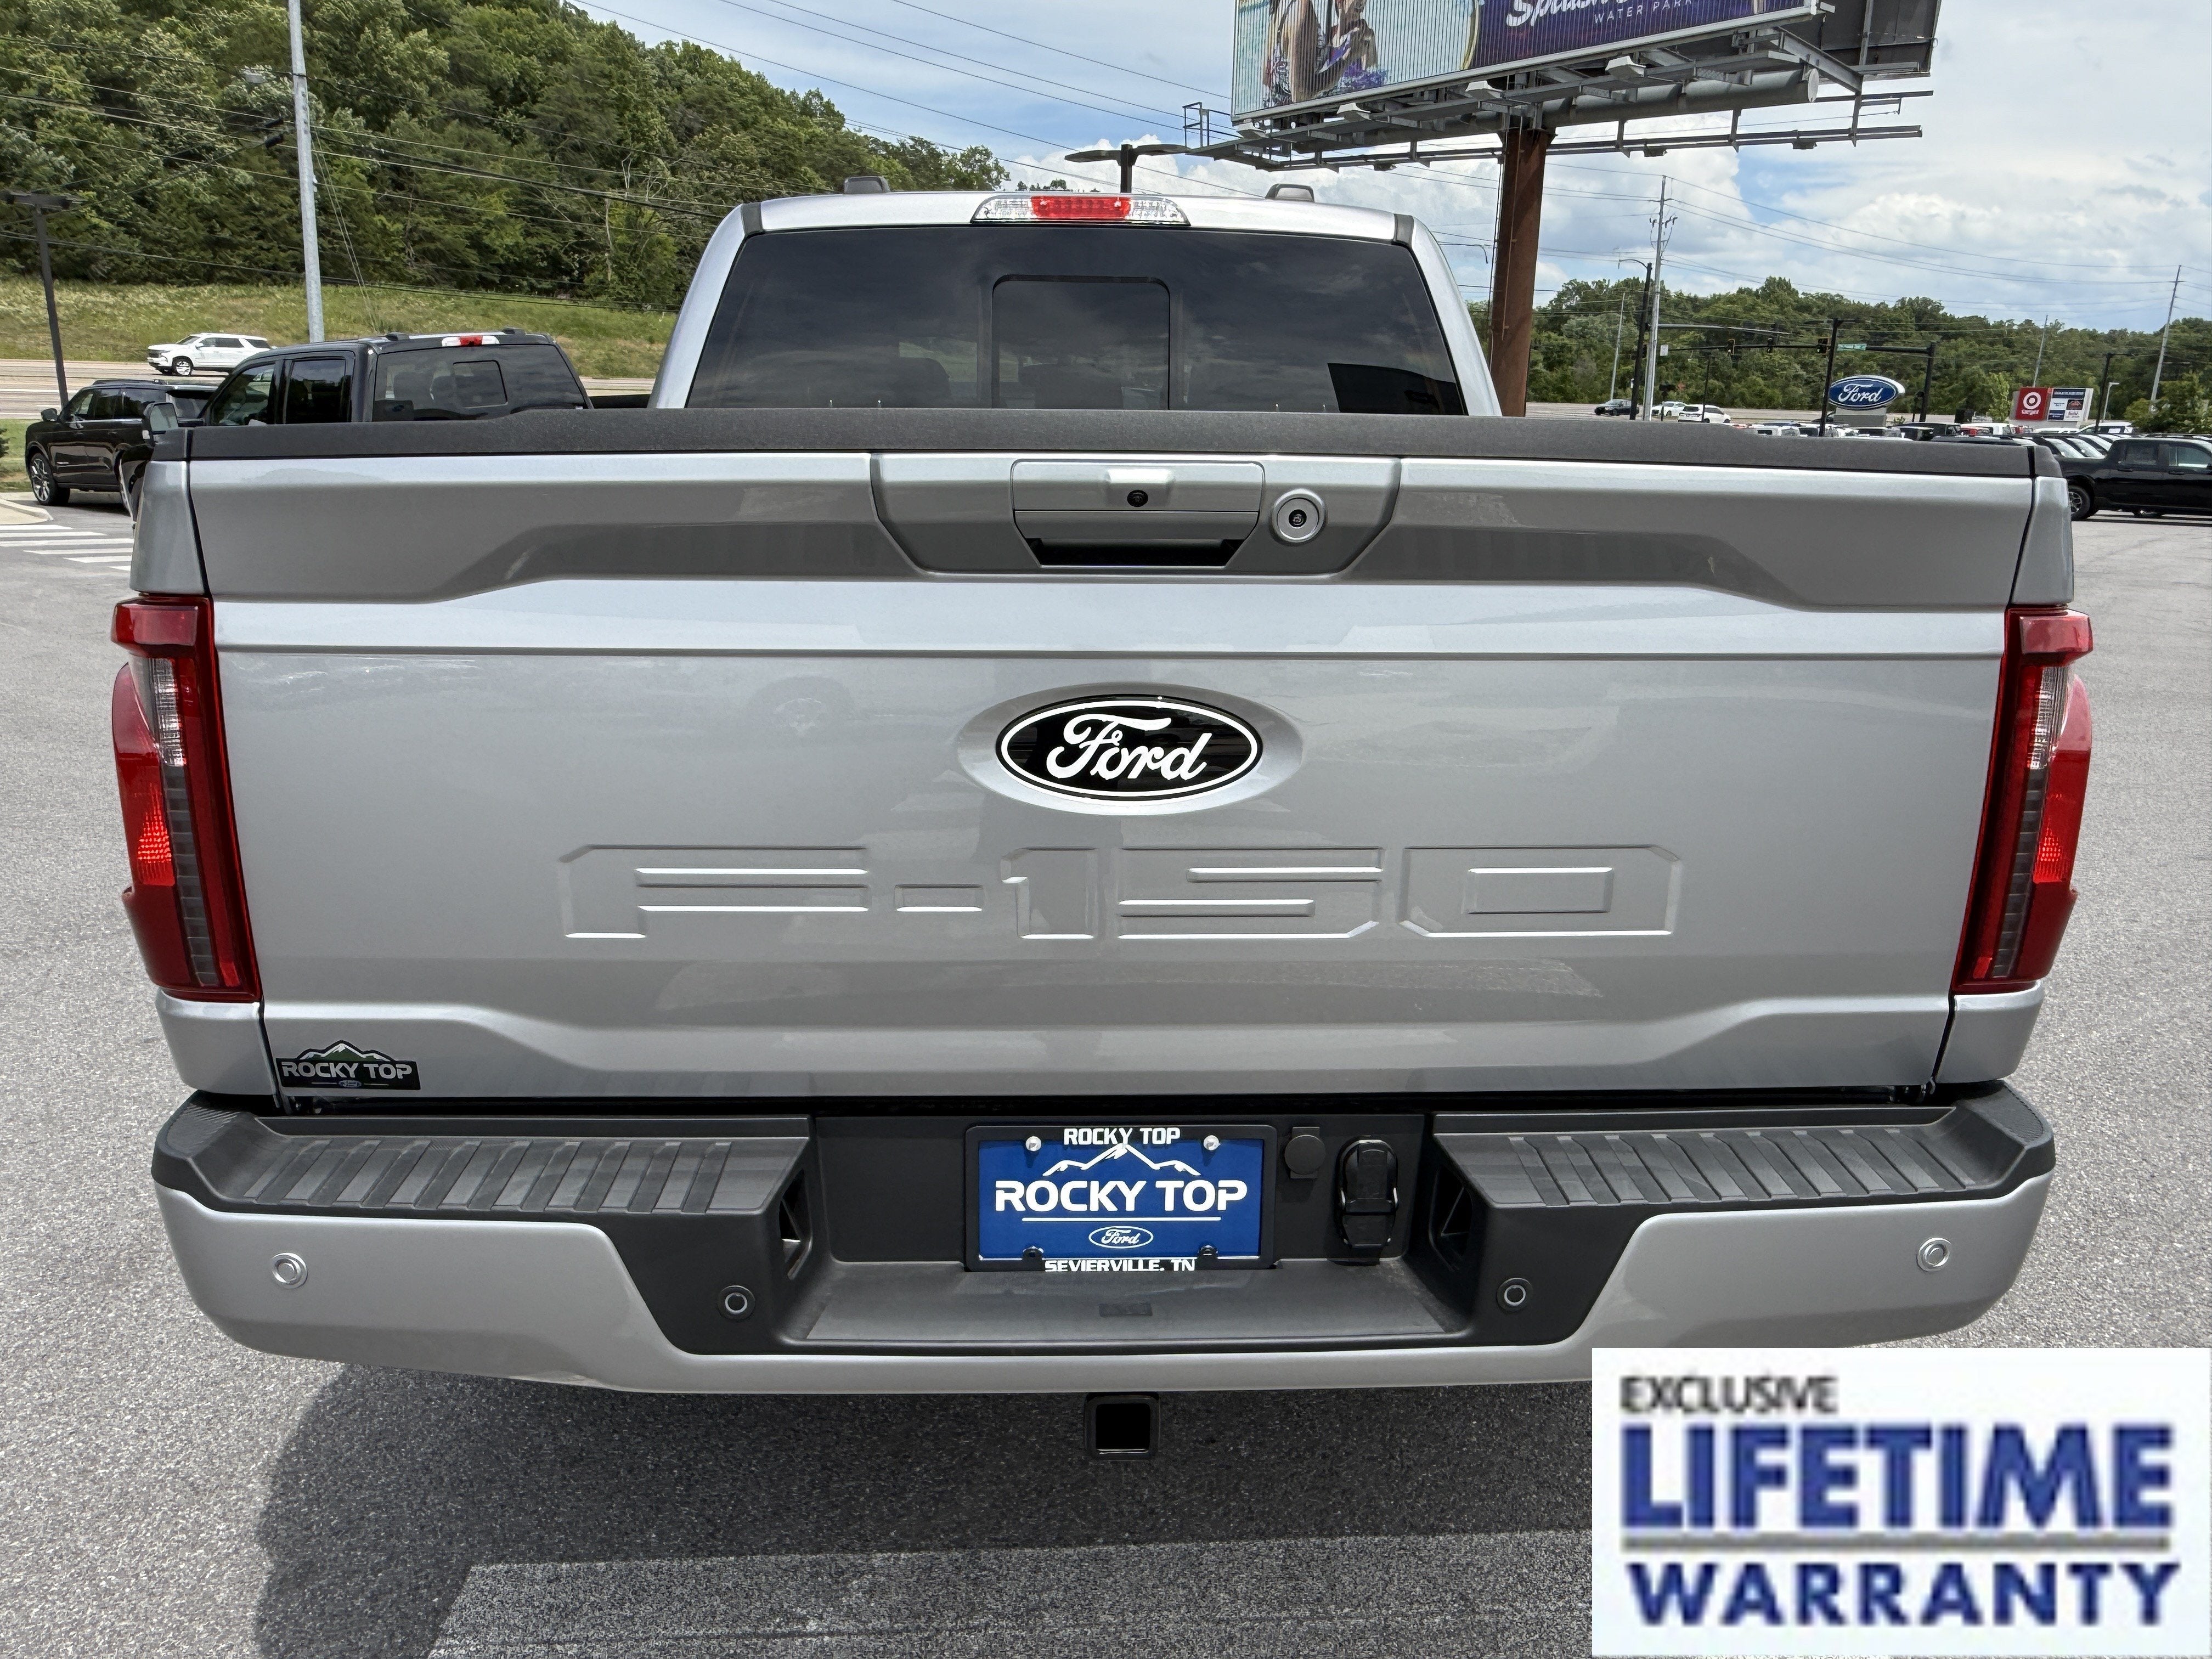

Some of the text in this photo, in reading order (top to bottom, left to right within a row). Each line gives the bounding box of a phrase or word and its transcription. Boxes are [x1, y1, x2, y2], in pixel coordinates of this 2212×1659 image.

[1594, 5, 1643, 23] WATER
[1838, 383, 1883, 402] Ford
[1046, 714, 1212, 780] Ford
[558, 845, 1682, 939] F-150
[281, 1062, 412, 1079] ROCKY TOP
[1064, 1127, 1180, 1146] ROCKY TOP
[995, 1180, 1248, 1212] ROCKY TOP
[1101, 1229, 1141, 1244] Ford
[1171, 1260, 1195, 1271] TN
